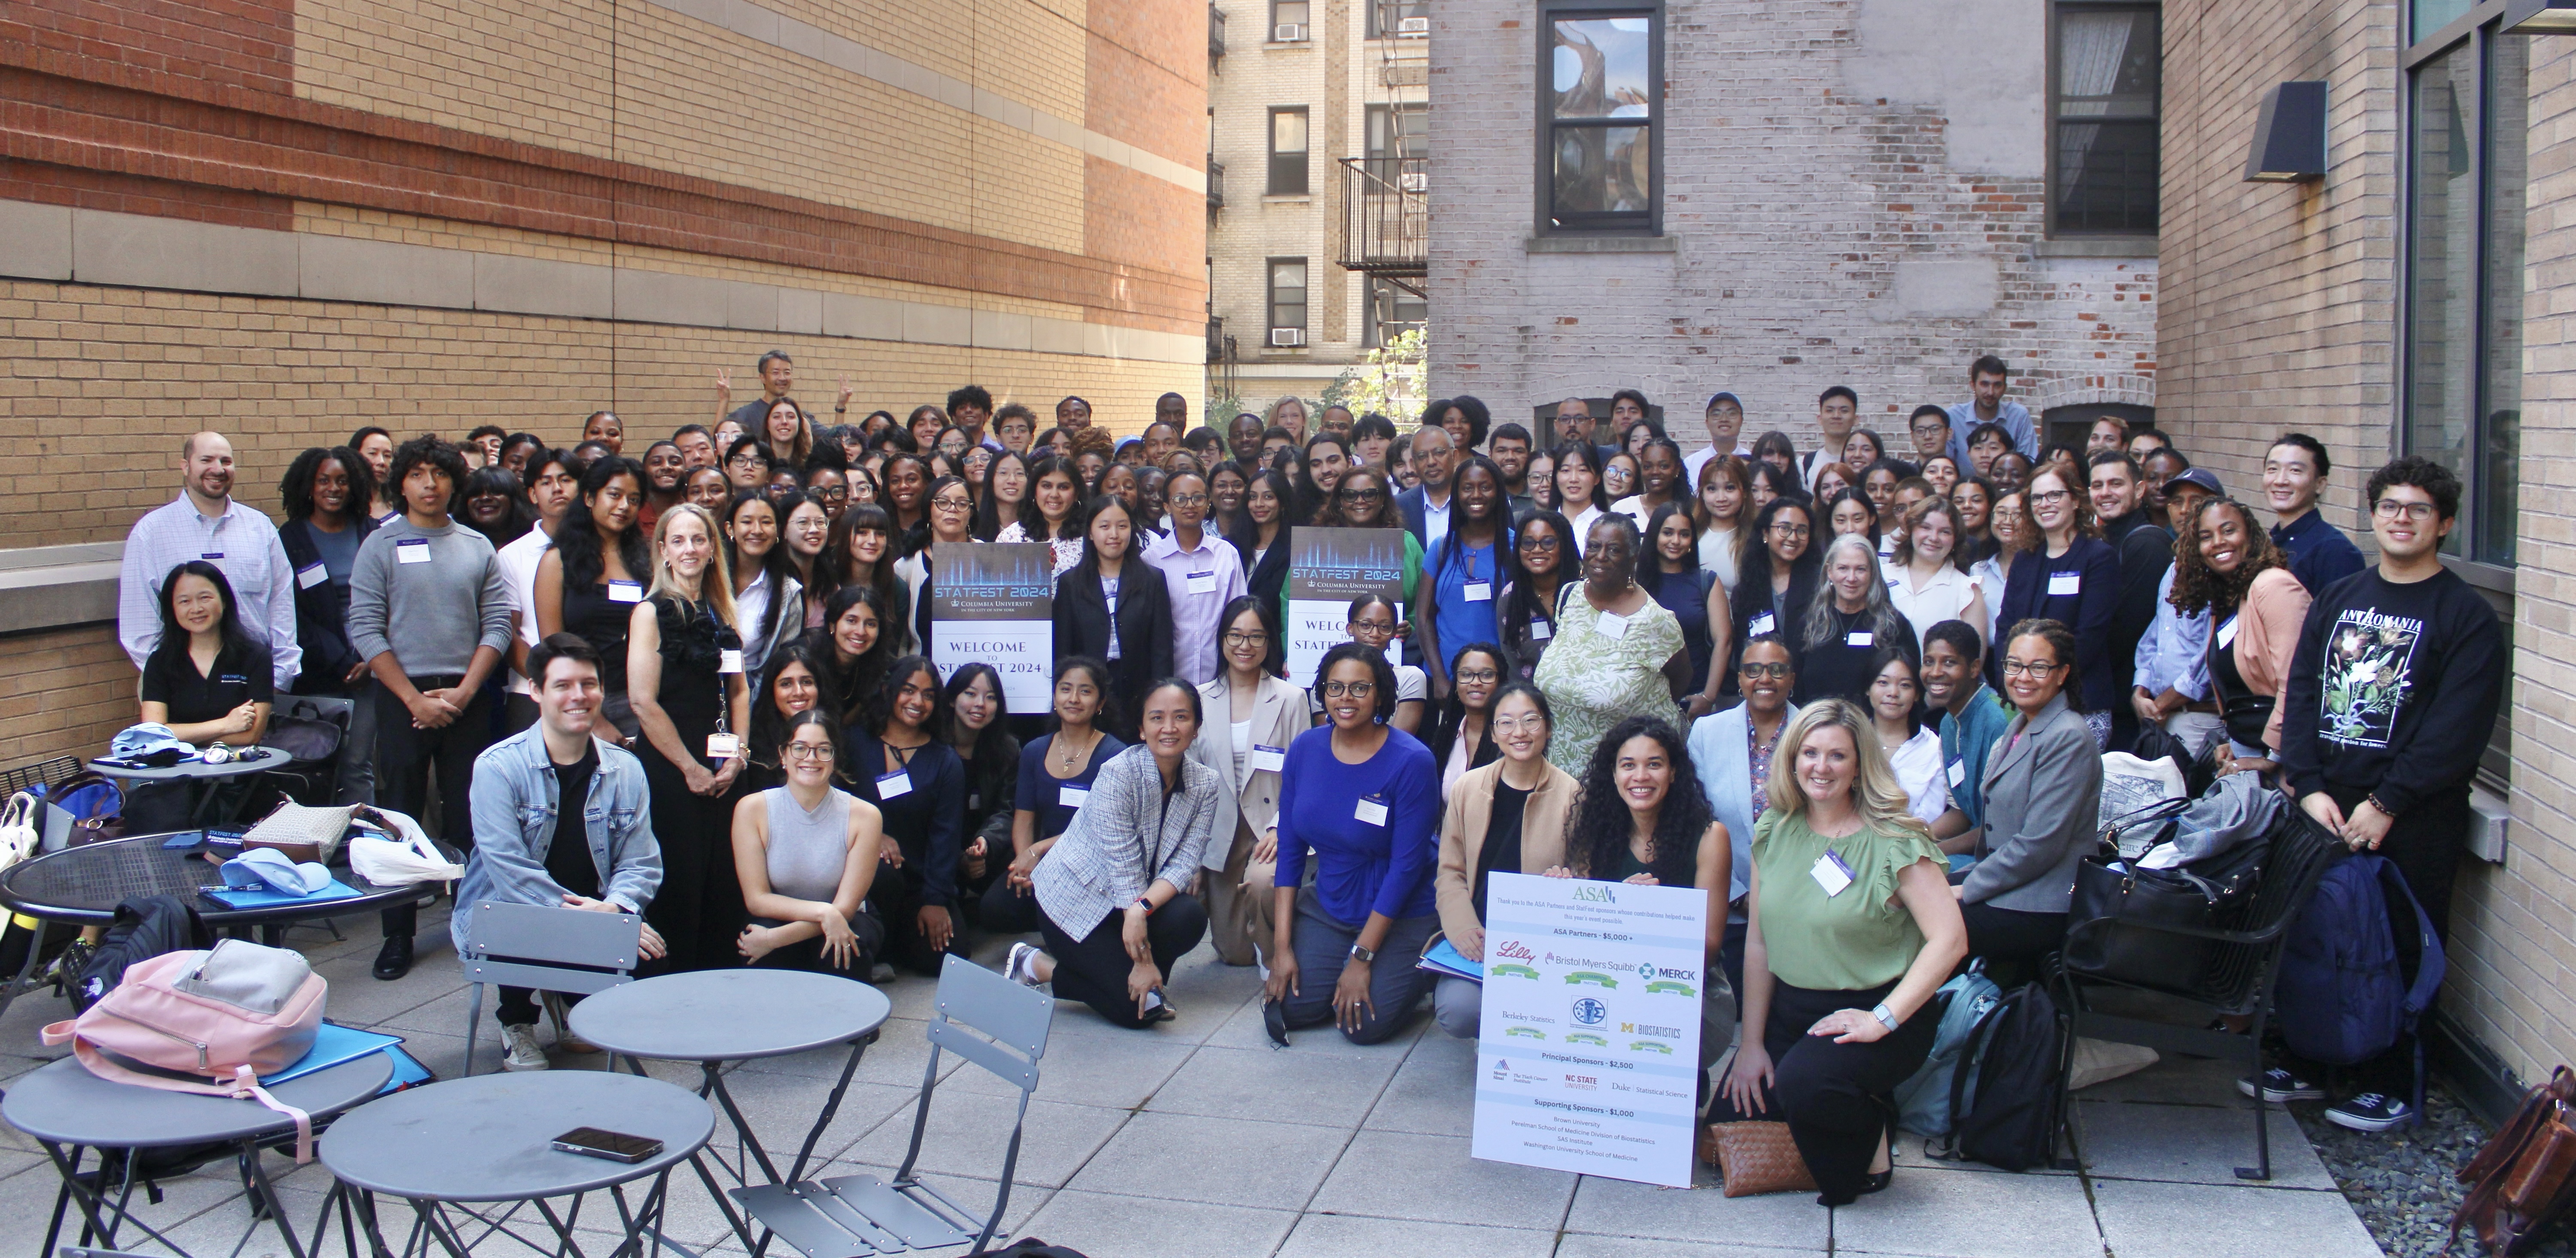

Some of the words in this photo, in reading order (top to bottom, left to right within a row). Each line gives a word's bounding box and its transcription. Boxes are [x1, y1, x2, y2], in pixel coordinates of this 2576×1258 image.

[1293, 569, 1358, 579] STATFEST
[1364, 571, 1400, 580] 2024
[935, 587, 1005, 597] STATFEST
[1010, 587, 1048, 597] 2024
[1306, 620, 1344, 631] WELC
[2338, 610, 2422, 632] ANTHOMANIA
[950, 642, 1026, 652] WELCOME
[1010, 663, 1041, 672] 2024
[1572, 886, 1608, 902] ASA
[1569, 930, 1597, 938] Partners
[1603, 933, 1628, 941] $5,000
[1496, 941, 1536, 965] Lilly
[1556, 956, 1580, 966] Bristol
[1583, 958, 1606, 969] Myers
[1659, 968, 1695, 981] MERCK
[1502, 1011, 1528, 1023] Berkeley
[1530, 1015, 1555, 1024] Statistics
[1621, 1022, 1634, 1033] M
[1638, 1024, 1680, 1039] BIOSTATISTICS
[1542, 1052, 1571, 1062] Principal
[1573, 1057, 1604, 1066] Sponsors
[1610, 1060, 1633, 1069] $2,500
[1565, 1082, 1597, 1091] UNIVERSITY
[1577, 1076, 1598, 1085] STATE
[1612, 1082, 1631, 1091] Duke
[1636, 1087, 1664, 1096] Statistical
[1665, 1091, 1688, 1099] Science
[1534, 1099, 1571, 1111] Supporting
[1573, 1104, 1604, 1113] Sponsors
[1610, 1108, 1634, 1117] $1,000
[1573, 1119, 1600, 1129] University
[1512, 1120, 1537, 1128] Perelman
[1565, 1128, 1589, 1136] Medicine
[1621, 1135, 1655, 1145] Biostatistics
[1570, 1137, 1593, 1146] Institute
[1524, 1141, 1555, 1151] Washington
[1557, 1146, 1585, 1156] University
[1586, 1149, 1604, 1158] School
[1613, 1153, 1638, 1162] Medicine
